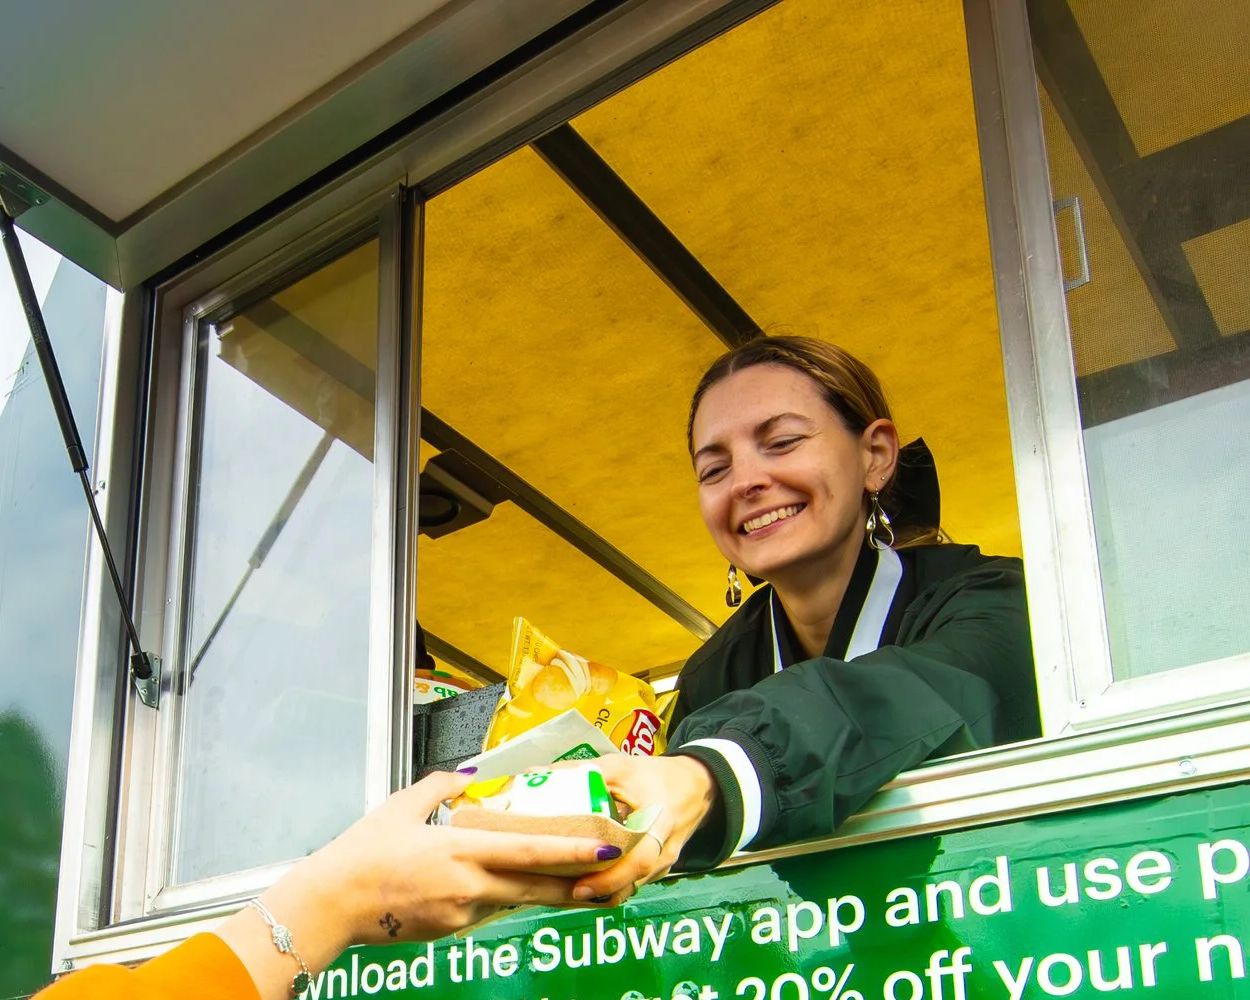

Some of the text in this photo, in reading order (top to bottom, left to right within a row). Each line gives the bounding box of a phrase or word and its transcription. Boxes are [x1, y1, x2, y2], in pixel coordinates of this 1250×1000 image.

[447, 937, 519, 983] the
[532, 914, 731, 973] Subway
[750, 893, 867, 952] app
[884, 855, 1014, 928] and
[1036, 849, 1174, 907] use
